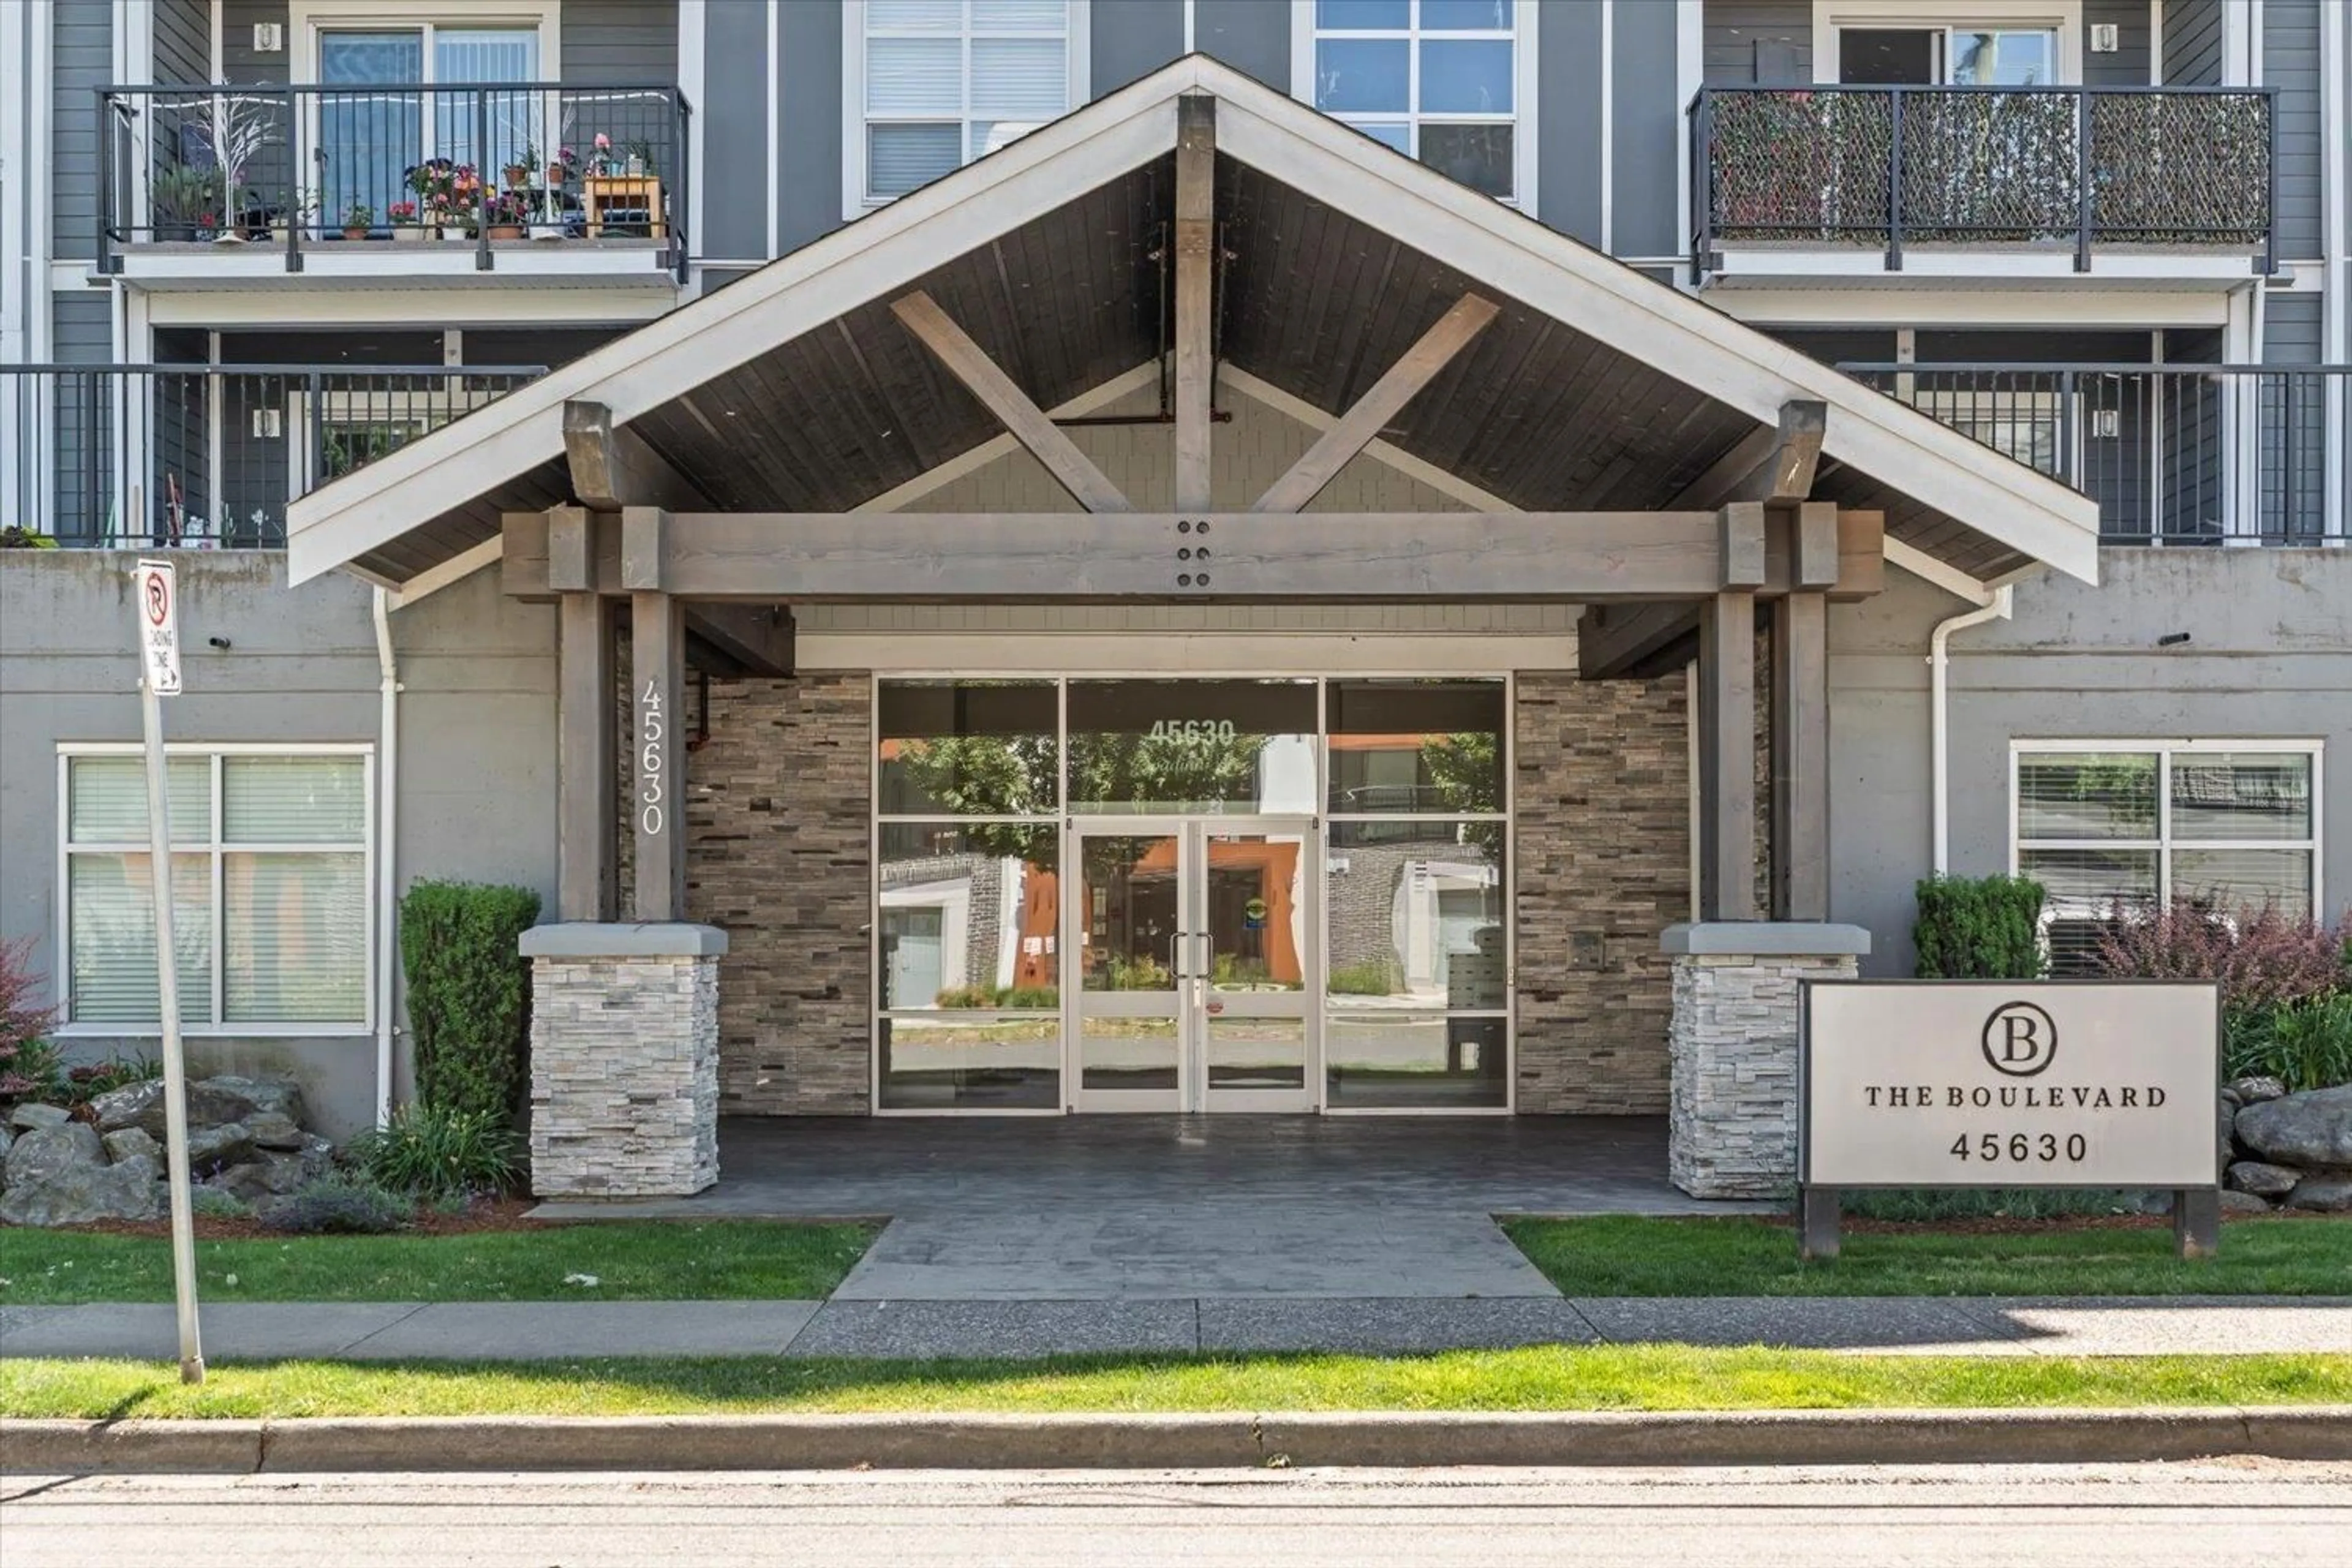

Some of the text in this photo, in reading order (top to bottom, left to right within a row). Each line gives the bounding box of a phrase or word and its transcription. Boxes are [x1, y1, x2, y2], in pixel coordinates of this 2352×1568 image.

[1148, 719, 1234, 747] 45630
[643, 680, 663, 835] 45630
[2002, 1016, 2038, 1062] B
[1865, 1086, 2166, 1108] THE BOULEVARD
[1950, 1133, 2086, 1162] 45630
